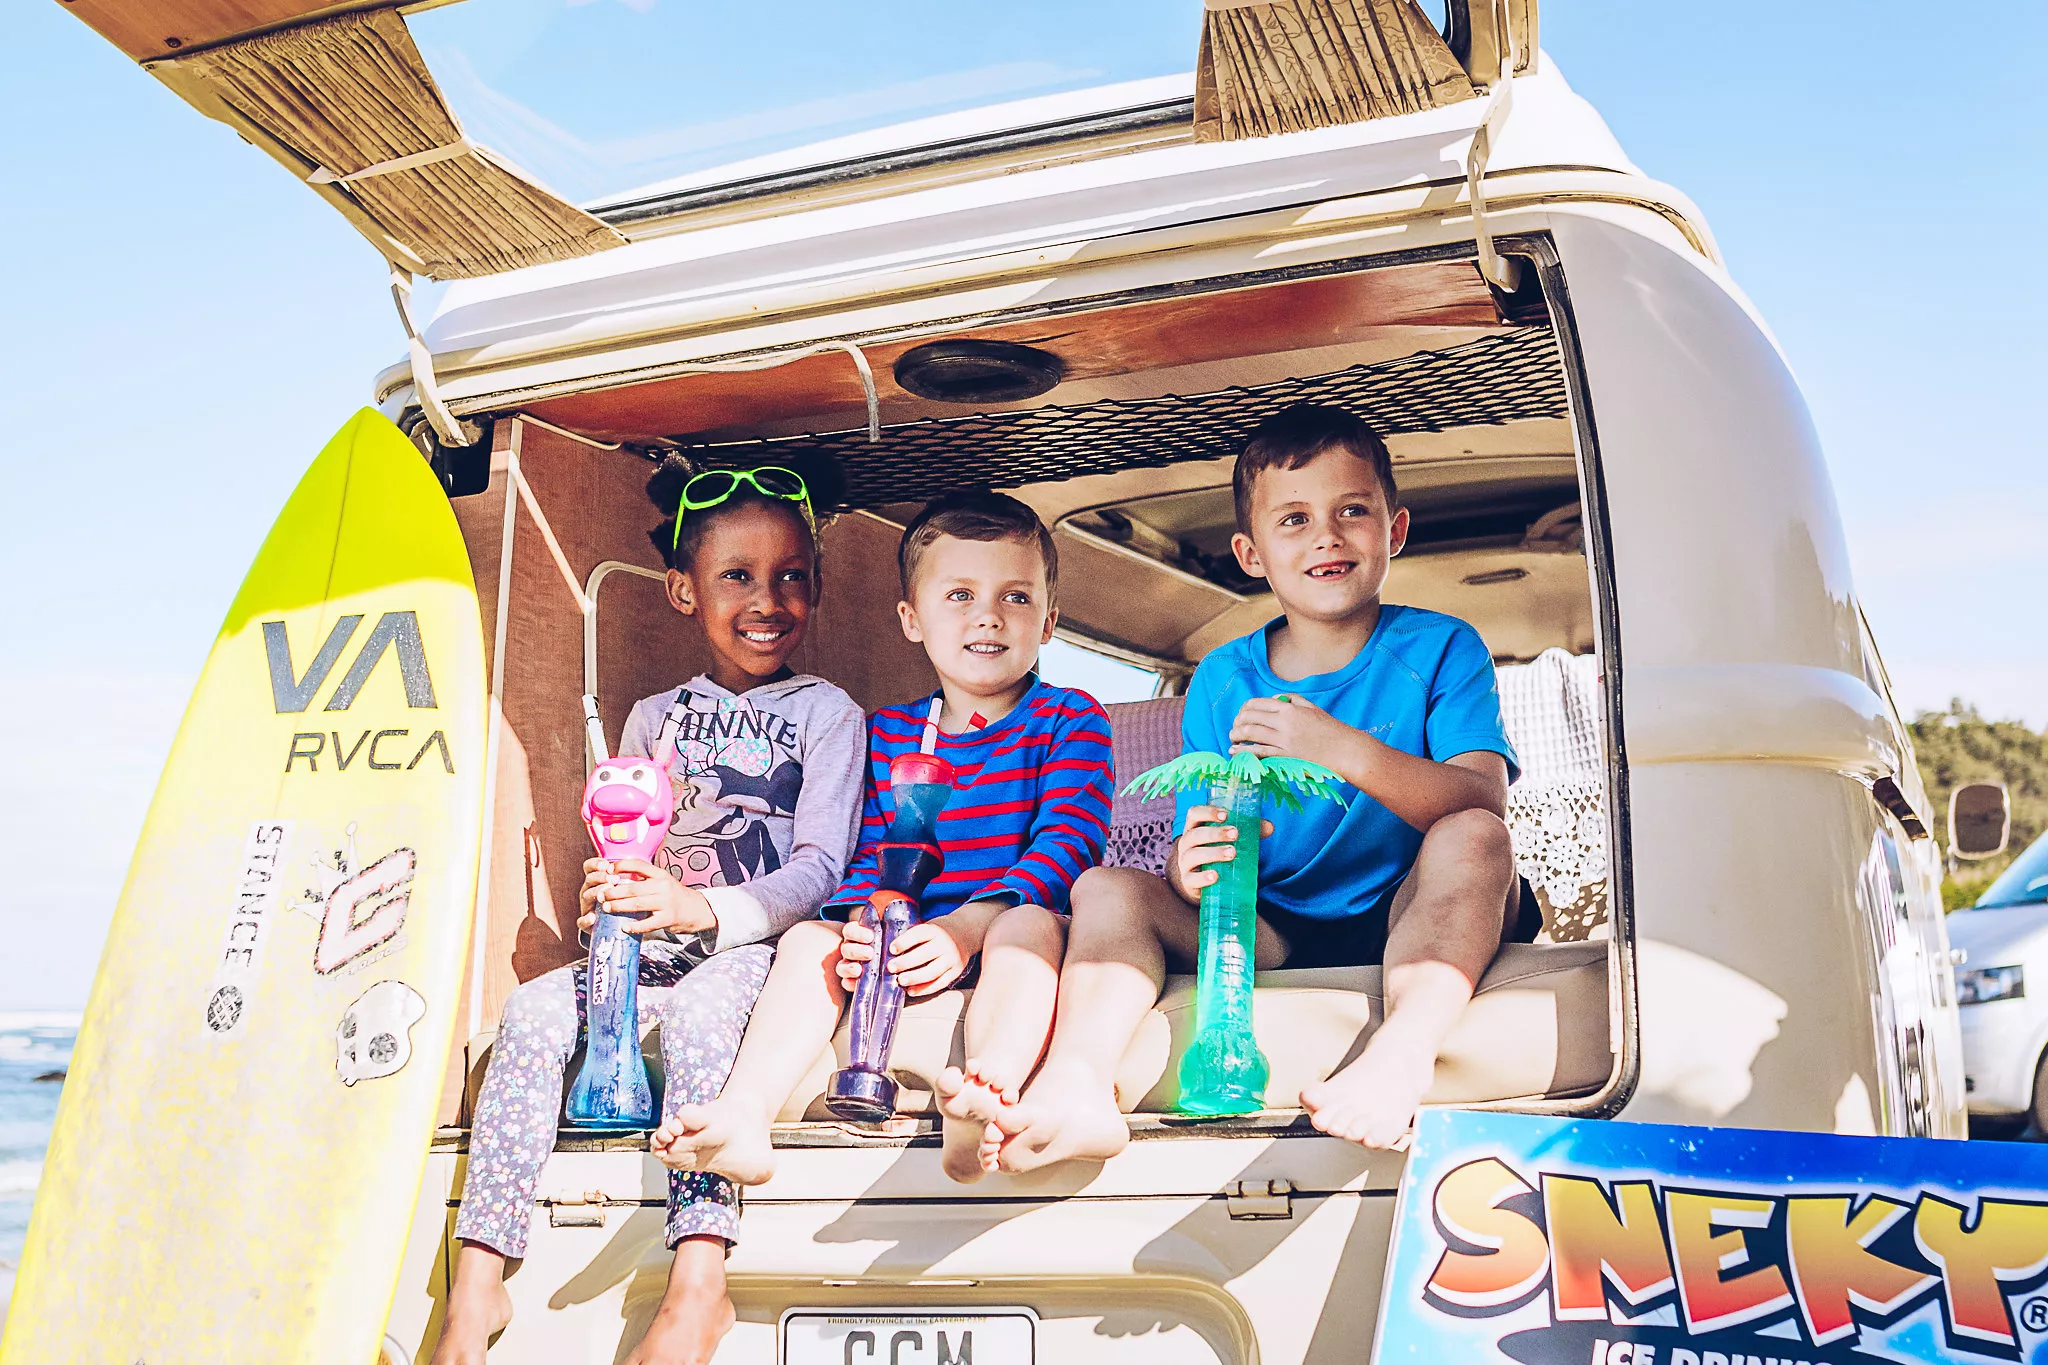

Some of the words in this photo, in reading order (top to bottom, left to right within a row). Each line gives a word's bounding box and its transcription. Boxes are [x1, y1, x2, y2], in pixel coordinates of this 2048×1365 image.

[285, 729, 455, 774] RVCA
[655, 709, 798, 750] MINNIE
[223, 825, 284, 968] STANCE
[1424, 1157, 2048, 1361] SNEKY
[828, 1317, 863, 1325] FRIENDLY
[865, 1317, 904, 1325] PROVINCE
[929, 1316, 965, 1324] EASTERN
